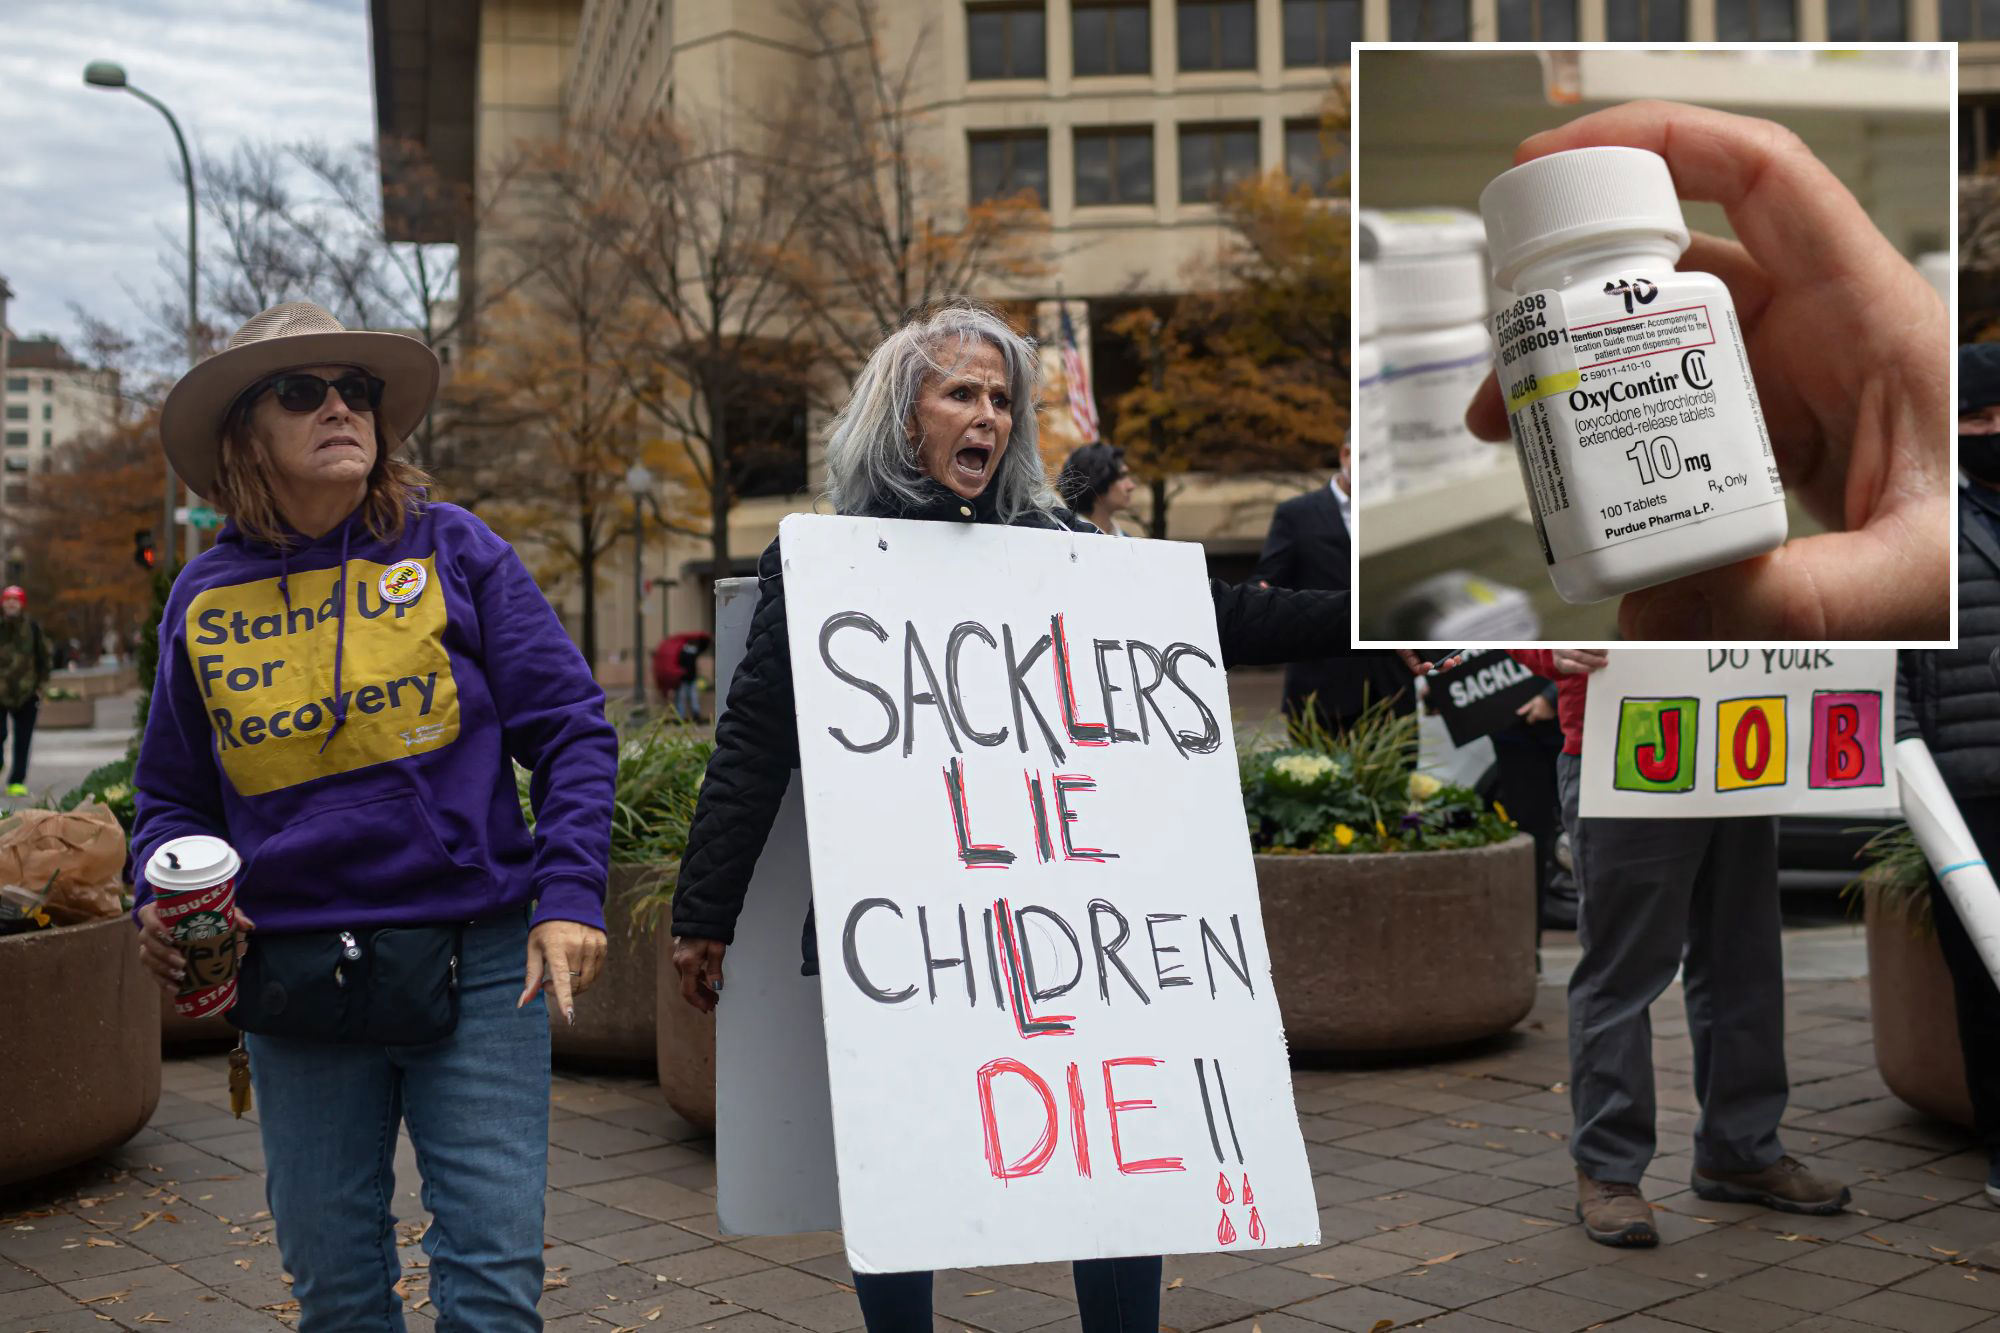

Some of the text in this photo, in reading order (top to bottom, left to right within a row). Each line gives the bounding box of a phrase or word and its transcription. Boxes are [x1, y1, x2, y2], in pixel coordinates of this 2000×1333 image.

[1603, 278, 1659, 315] 40
[1603, 335, 1626, 347] Guide
[1626, 332, 1645, 343] must
[1646, 330, 1656, 339] be
[1656, 325, 1688, 339] provided
[1688, 324, 1696, 333] to
[1696, 321, 1708, 331] the
[1604, 322, 1647, 340] Dispenser:
[1647, 312, 1698, 328] Accompanying
[1589, 360, 1652, 380] 59011-410-10
[1594, 349, 1622, 362] patient
[1622, 344, 1641, 356] upon
[1574, 389, 1717, 435] (oxycodone hydrochloride)
[1579, 406, 1716, 448] extended-release tablets
[1550, 445, 1561, 475] chew,
[1626, 435, 1712, 486] 10 mg
[1724, 472, 1748, 488] Only
[1600, 493, 1668, 520] 100 Tablets
[1604, 502, 1715, 540] Purdue Pharma L.P.
[195, 580, 342, 646] Stand
[198, 654, 286, 698] For
[819, 611, 1223, 767] SACKLERS
[211, 671, 438, 750] Recovery
[1634, 704, 1864, 784] JOB
[944, 756, 1121, 869] LIE
[842, 897, 1260, 1039] CHILDREN
